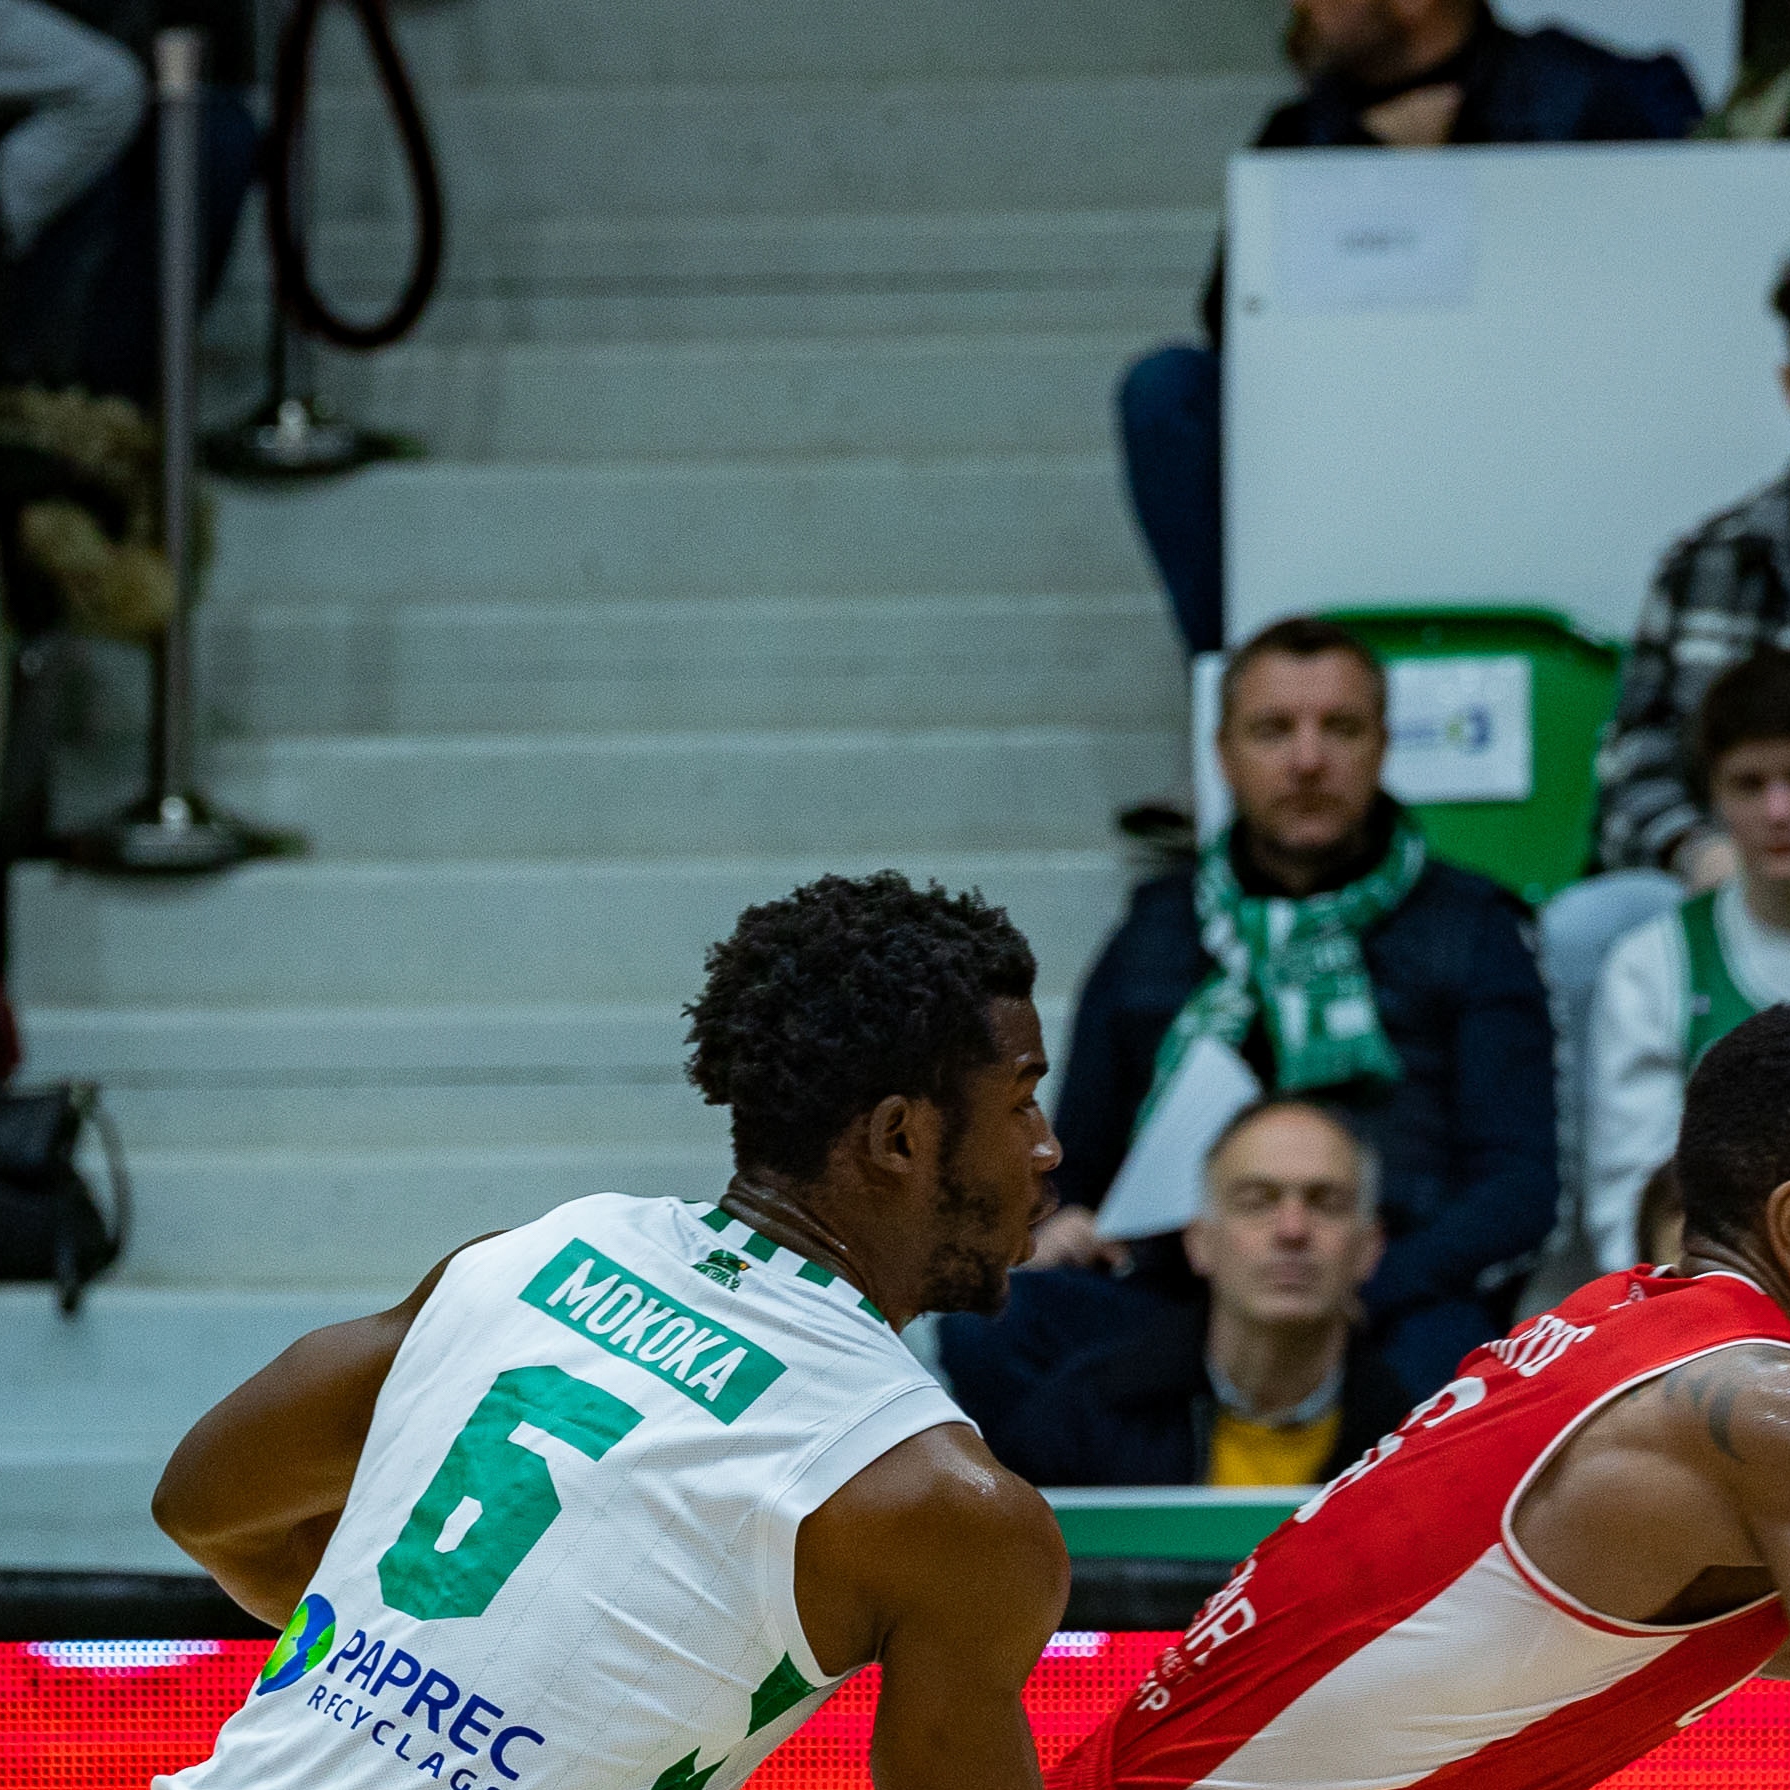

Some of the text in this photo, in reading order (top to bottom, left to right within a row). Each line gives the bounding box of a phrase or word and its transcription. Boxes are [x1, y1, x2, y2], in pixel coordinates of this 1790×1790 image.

[546, 1255, 749, 1405] MOKOKA
[380, 1368, 643, 1618] 6
[326, 1628, 546, 1782] PAPREC
